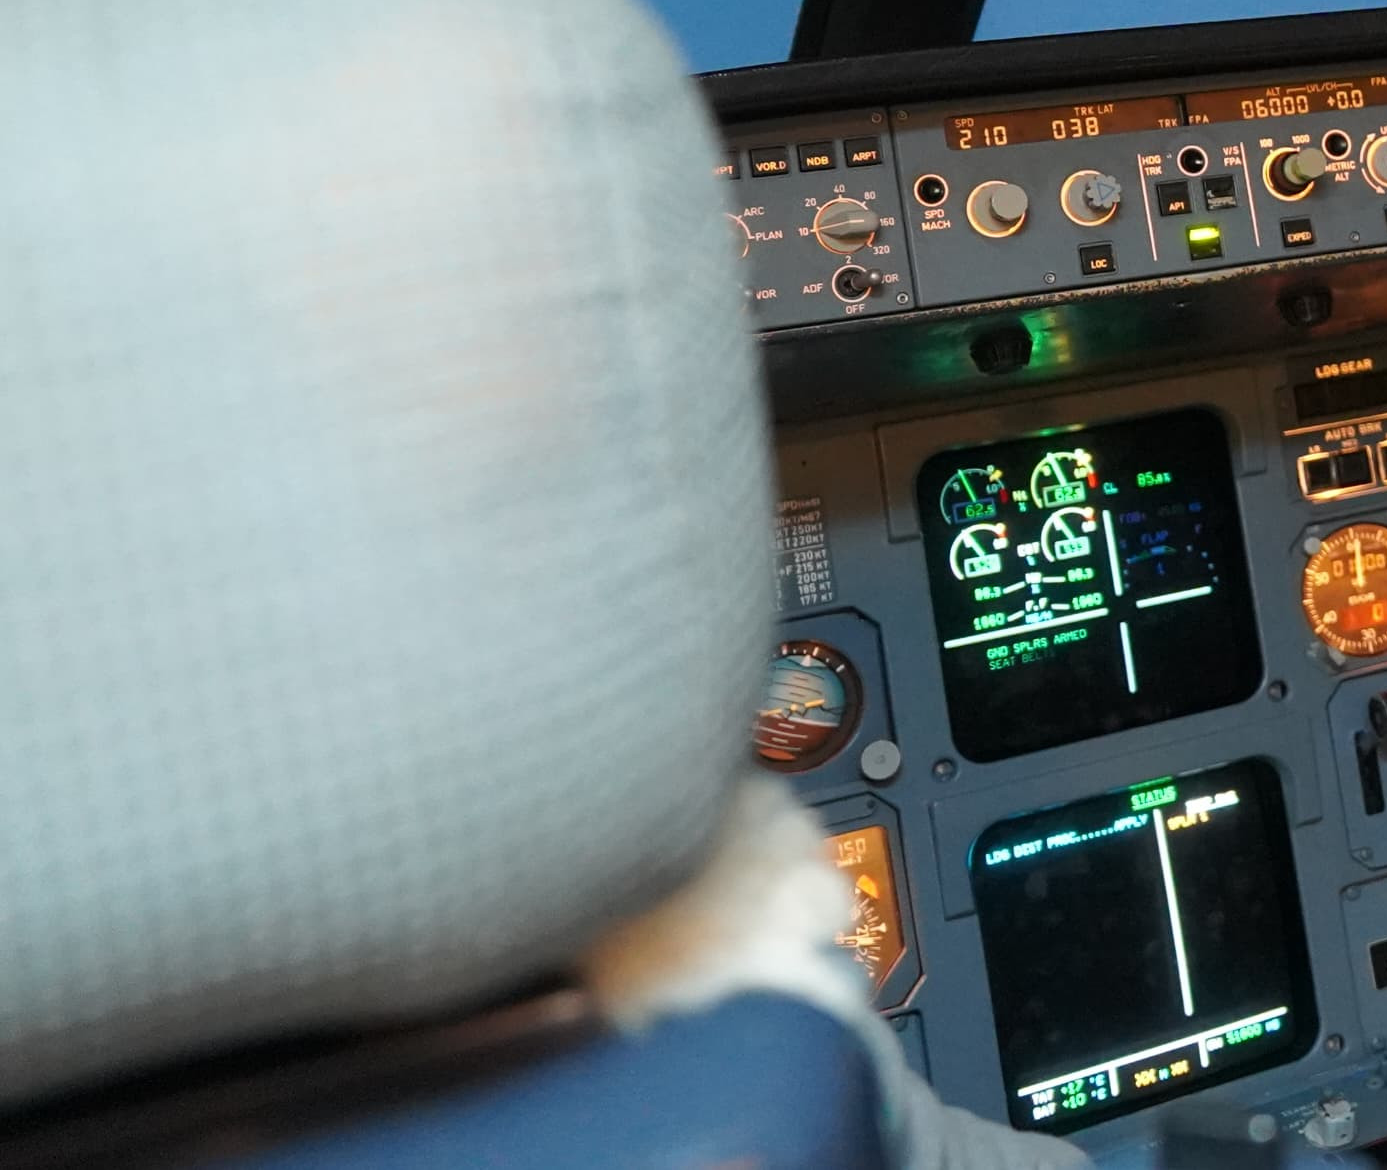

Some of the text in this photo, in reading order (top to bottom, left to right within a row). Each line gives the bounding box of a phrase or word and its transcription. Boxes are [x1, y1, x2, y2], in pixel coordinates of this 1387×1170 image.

[1266, 86, 1281, 97] ALT
[1371, 76, 1387, 87] FPA
[1241, 88, 1364, 120] 06000 +0.0
[954, 103, 1115, 128] SPD TRK LAT
[1158, 114, 1210, 129] TRK FPA
[959, 117, 1100, 150] 210 038
[1260, 134, 1311, 149] 100 1000
[852, 150, 878, 162] ARPT
[1223, 145, 1240, 156] V/S
[806, 156, 830, 168] NDB
[1142, 154, 1162, 166] HDG
[1224, 156, 1242, 168] FPA
[1324, 160, 1356, 172] METRIC
[756, 161, 787, 173] VOR.D
[1144, 166, 1163, 177] TRK
[1335, 171, 1351, 183] ALT
[833, 183, 846, 195] 40
[864, 190, 876, 201] 80
[804, 198, 817, 209] 20
[1169, 201, 1186, 212] AP1
[743, 206, 765, 219] ARC
[924, 208, 945, 220] SPD
[879, 217, 896, 228] 160
[921, 220, 951, 231] MACH
[755, 230, 784, 243] PLAN
[798, 227, 809, 238] 10
[1287, 231, 1312, 243] EXPED
[872, 245, 891, 257] 320
[1090, 258, 1108, 270] LOC
[802, 283, 824, 296] ADF
[845, 303, 866, 315] OFF
[1340, 357, 1374, 375] GEAR
[1325, 427, 1356, 442] AUTO
[966, 503, 995, 518] 62.5
[987, 629, 1088, 660] GND SPLRS ARMED
[989, 655, 1015, 671] SEAT
[1131, 785, 1178, 810] STATUS
